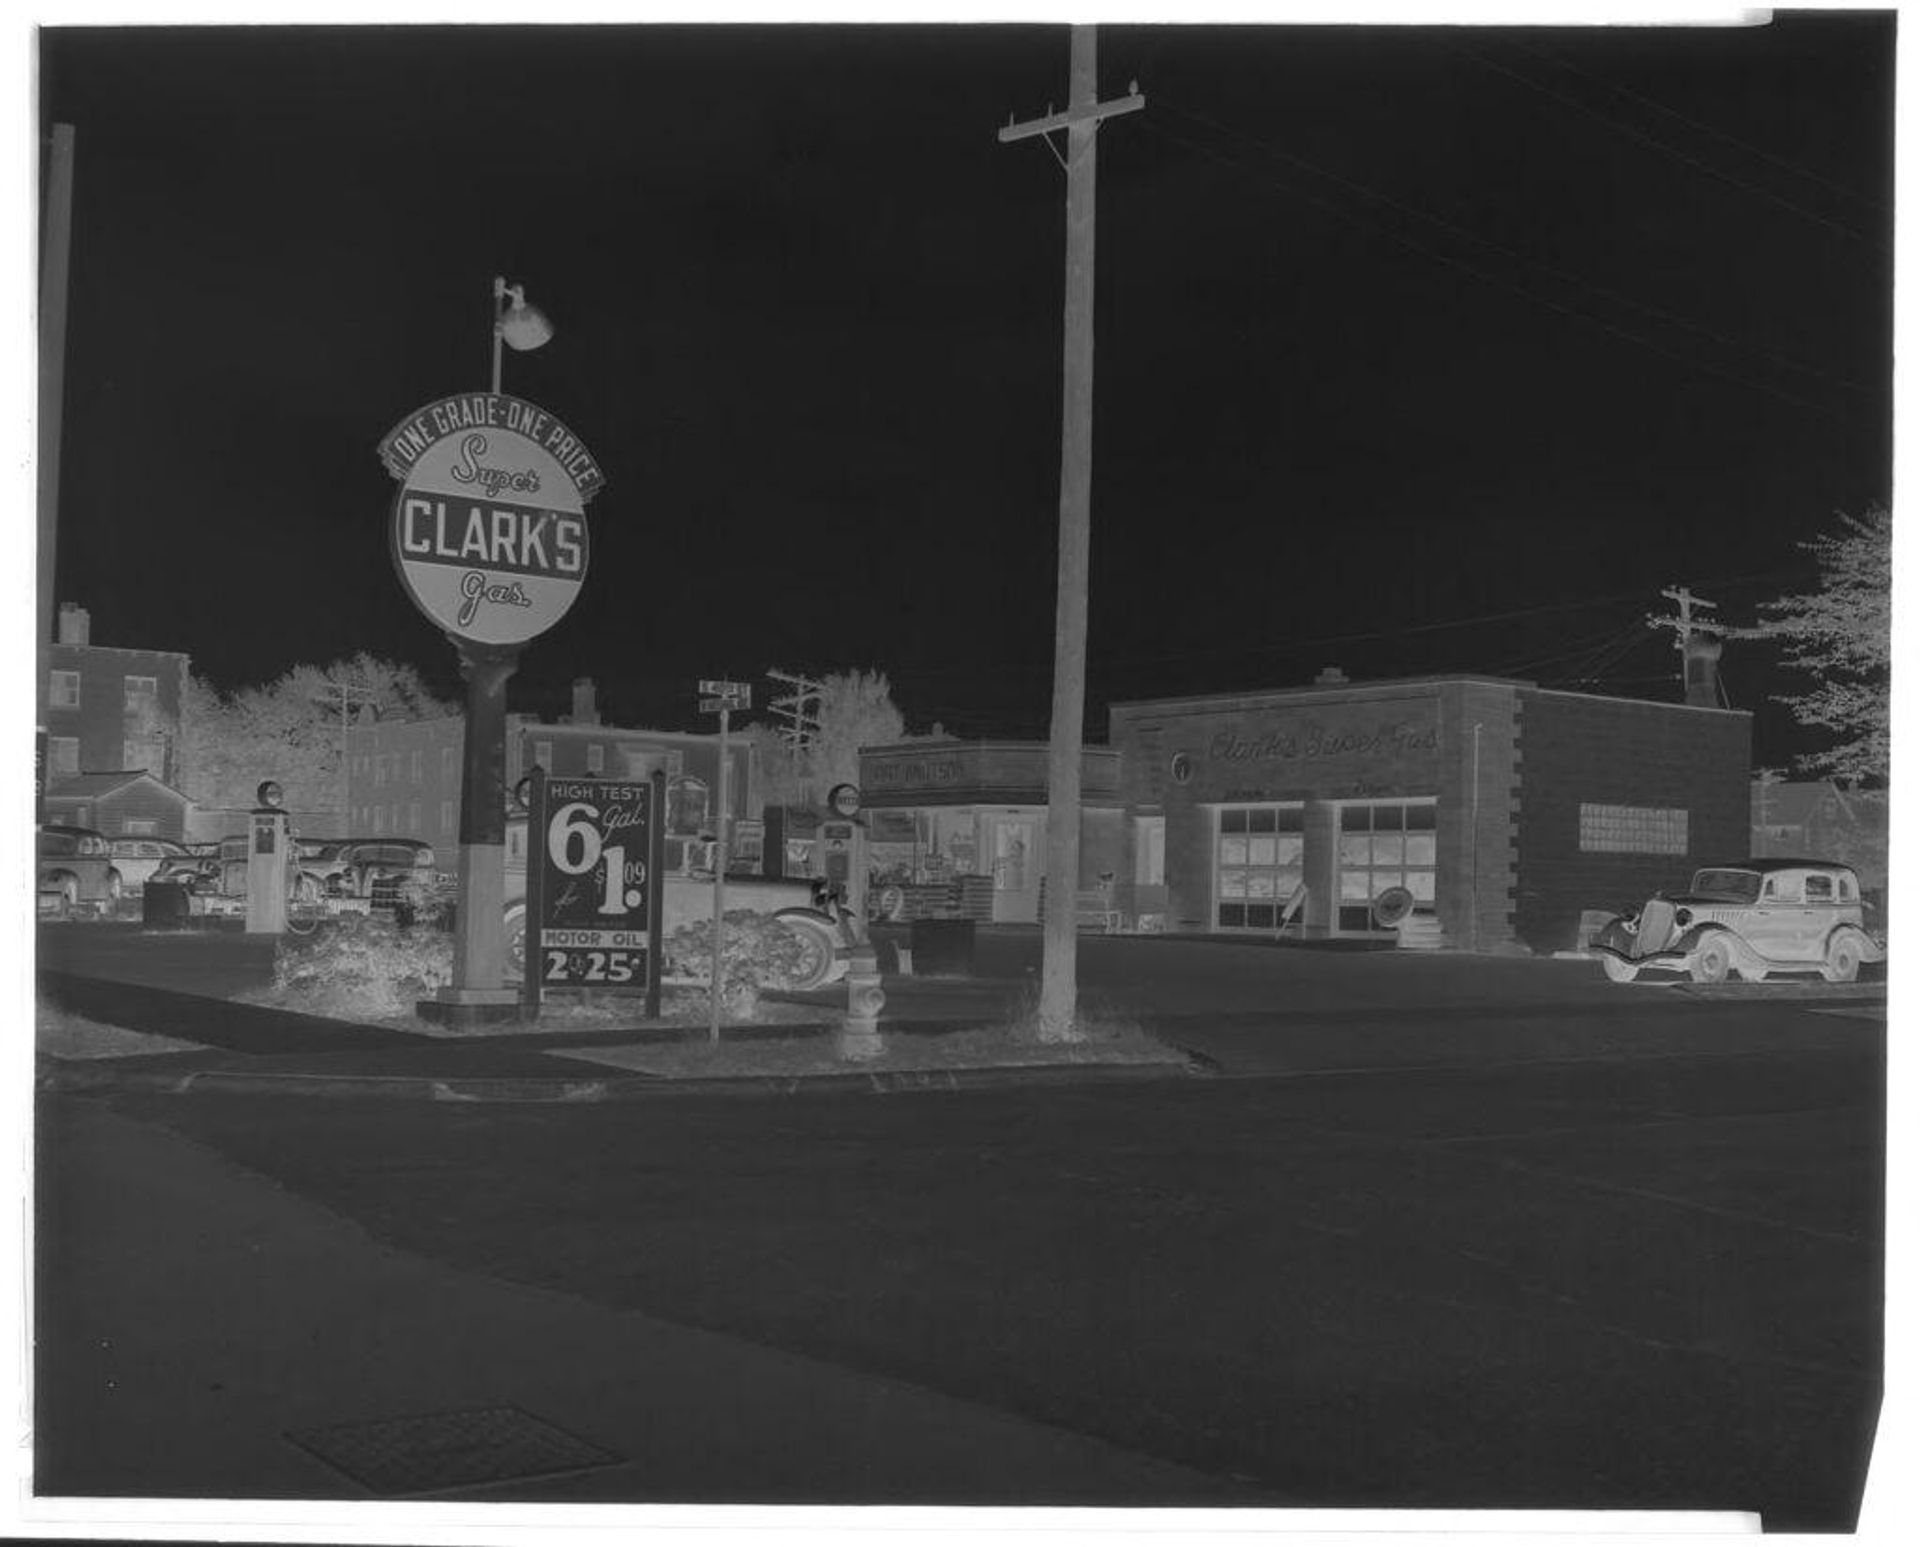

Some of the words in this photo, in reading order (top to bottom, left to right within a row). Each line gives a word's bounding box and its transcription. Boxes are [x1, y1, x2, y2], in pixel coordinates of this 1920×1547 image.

[395, 417, 434, 461] ONE
[544, 427, 599, 488] PRICE
[453, 433, 542, 497] Super
[404, 499, 581, 571] CLARK'S
[551, 785, 594, 799] HIGH
[600, 786, 644, 800] TEST
[549, 802, 601, 873] 6
[545, 932, 601, 945] MOTOR
[612, 933, 643, 946] OIL
[546, 951, 568, 980] 2
